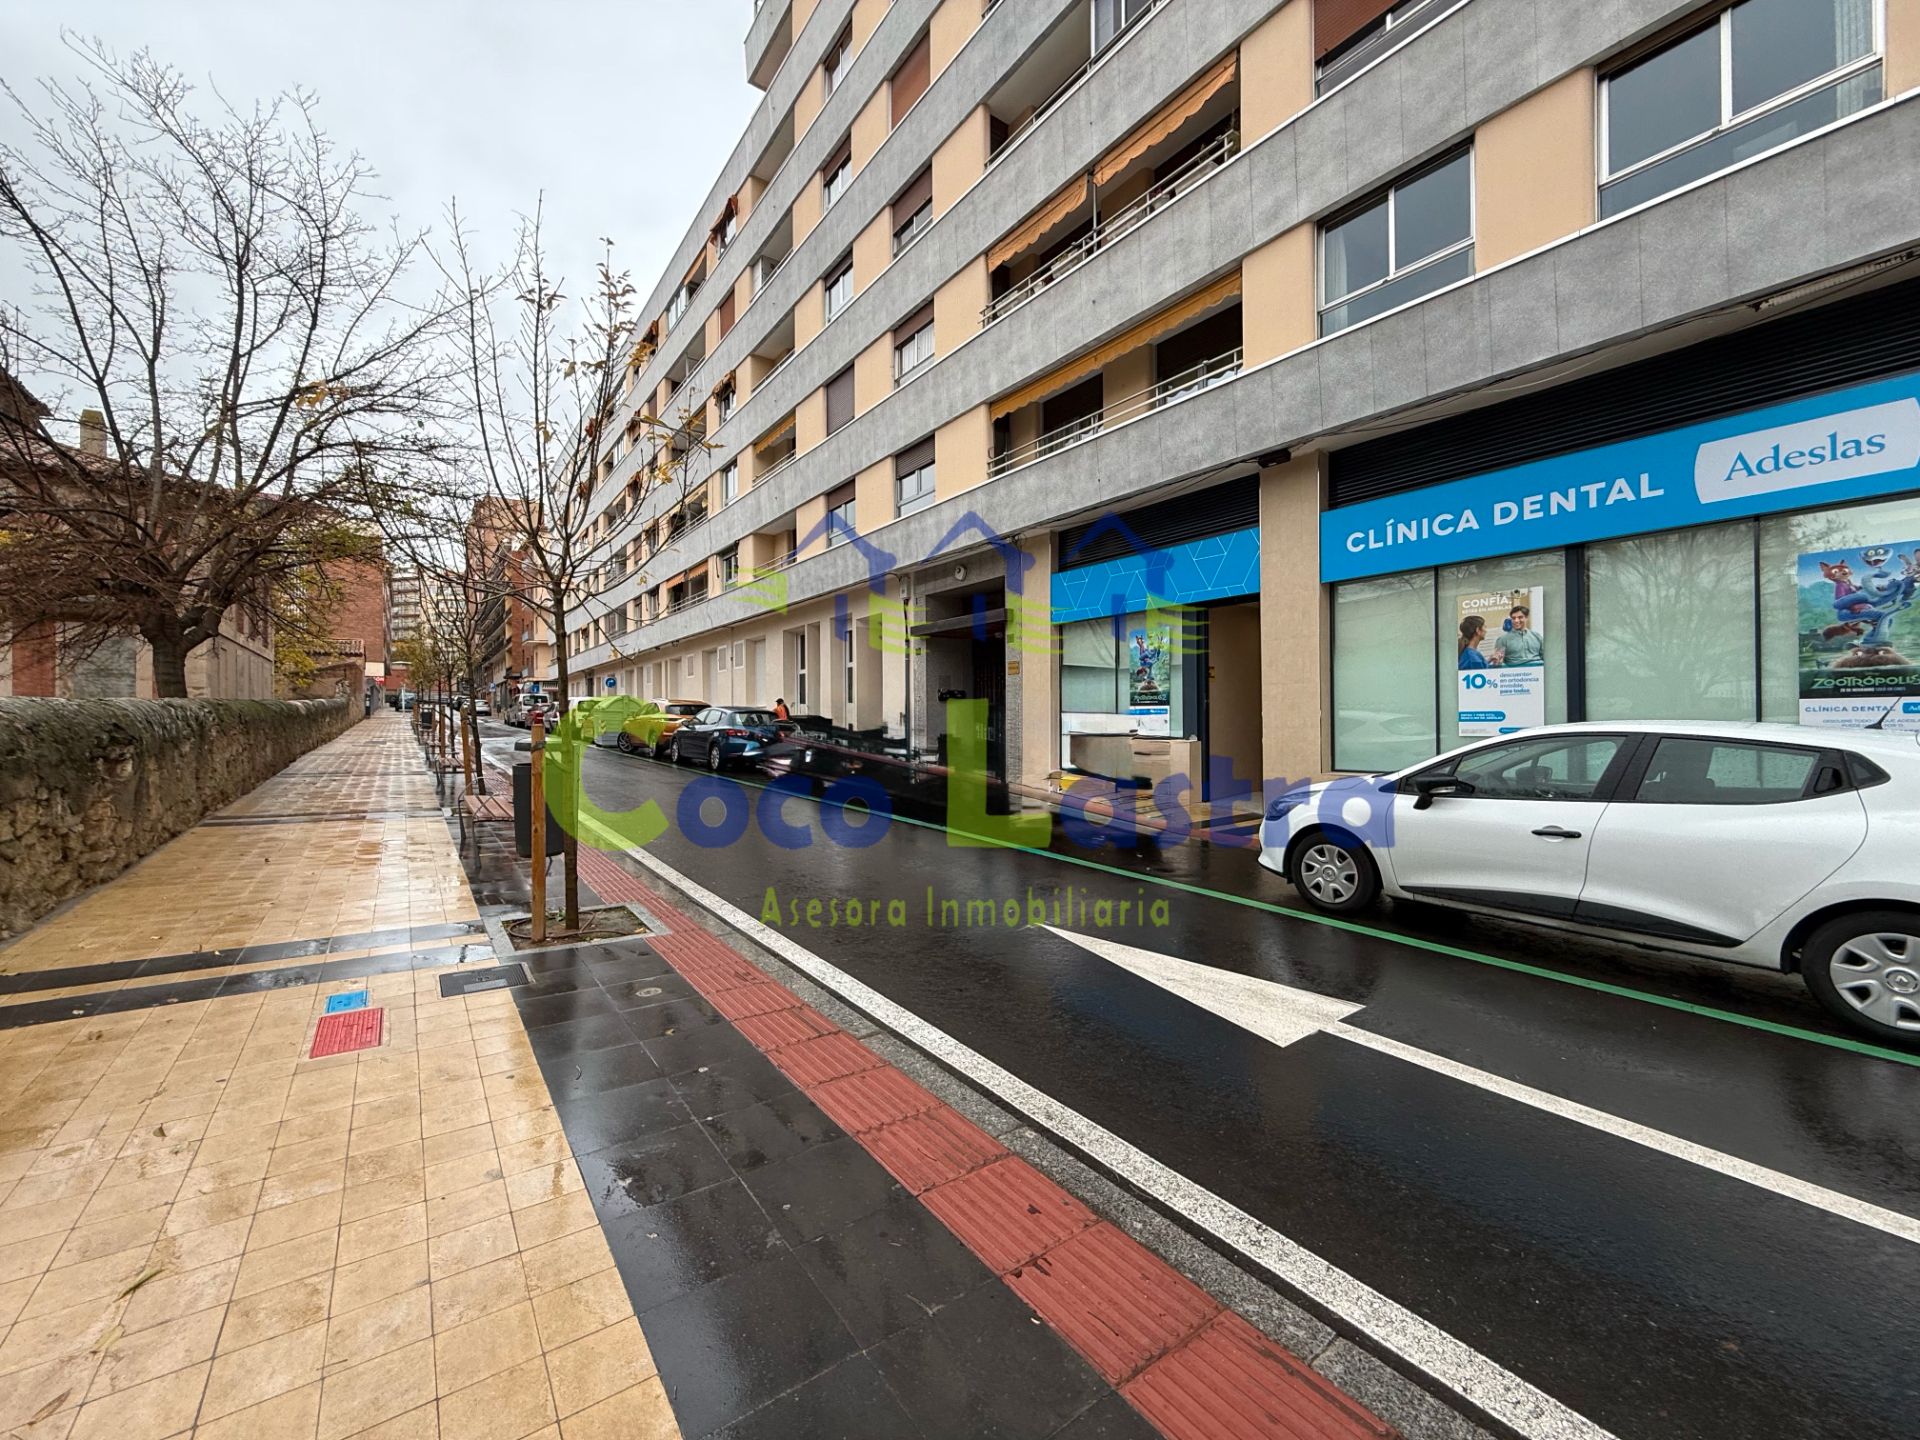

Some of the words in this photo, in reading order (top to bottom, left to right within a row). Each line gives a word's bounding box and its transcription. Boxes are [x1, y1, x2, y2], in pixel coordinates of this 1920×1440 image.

[1723, 430, 1886, 482] Adeslas
[1346, 508, 1480, 554] CLÍNICA
[1493, 472, 1665, 526] DENTAL
[1462, 673, 1498, 689] 10%
